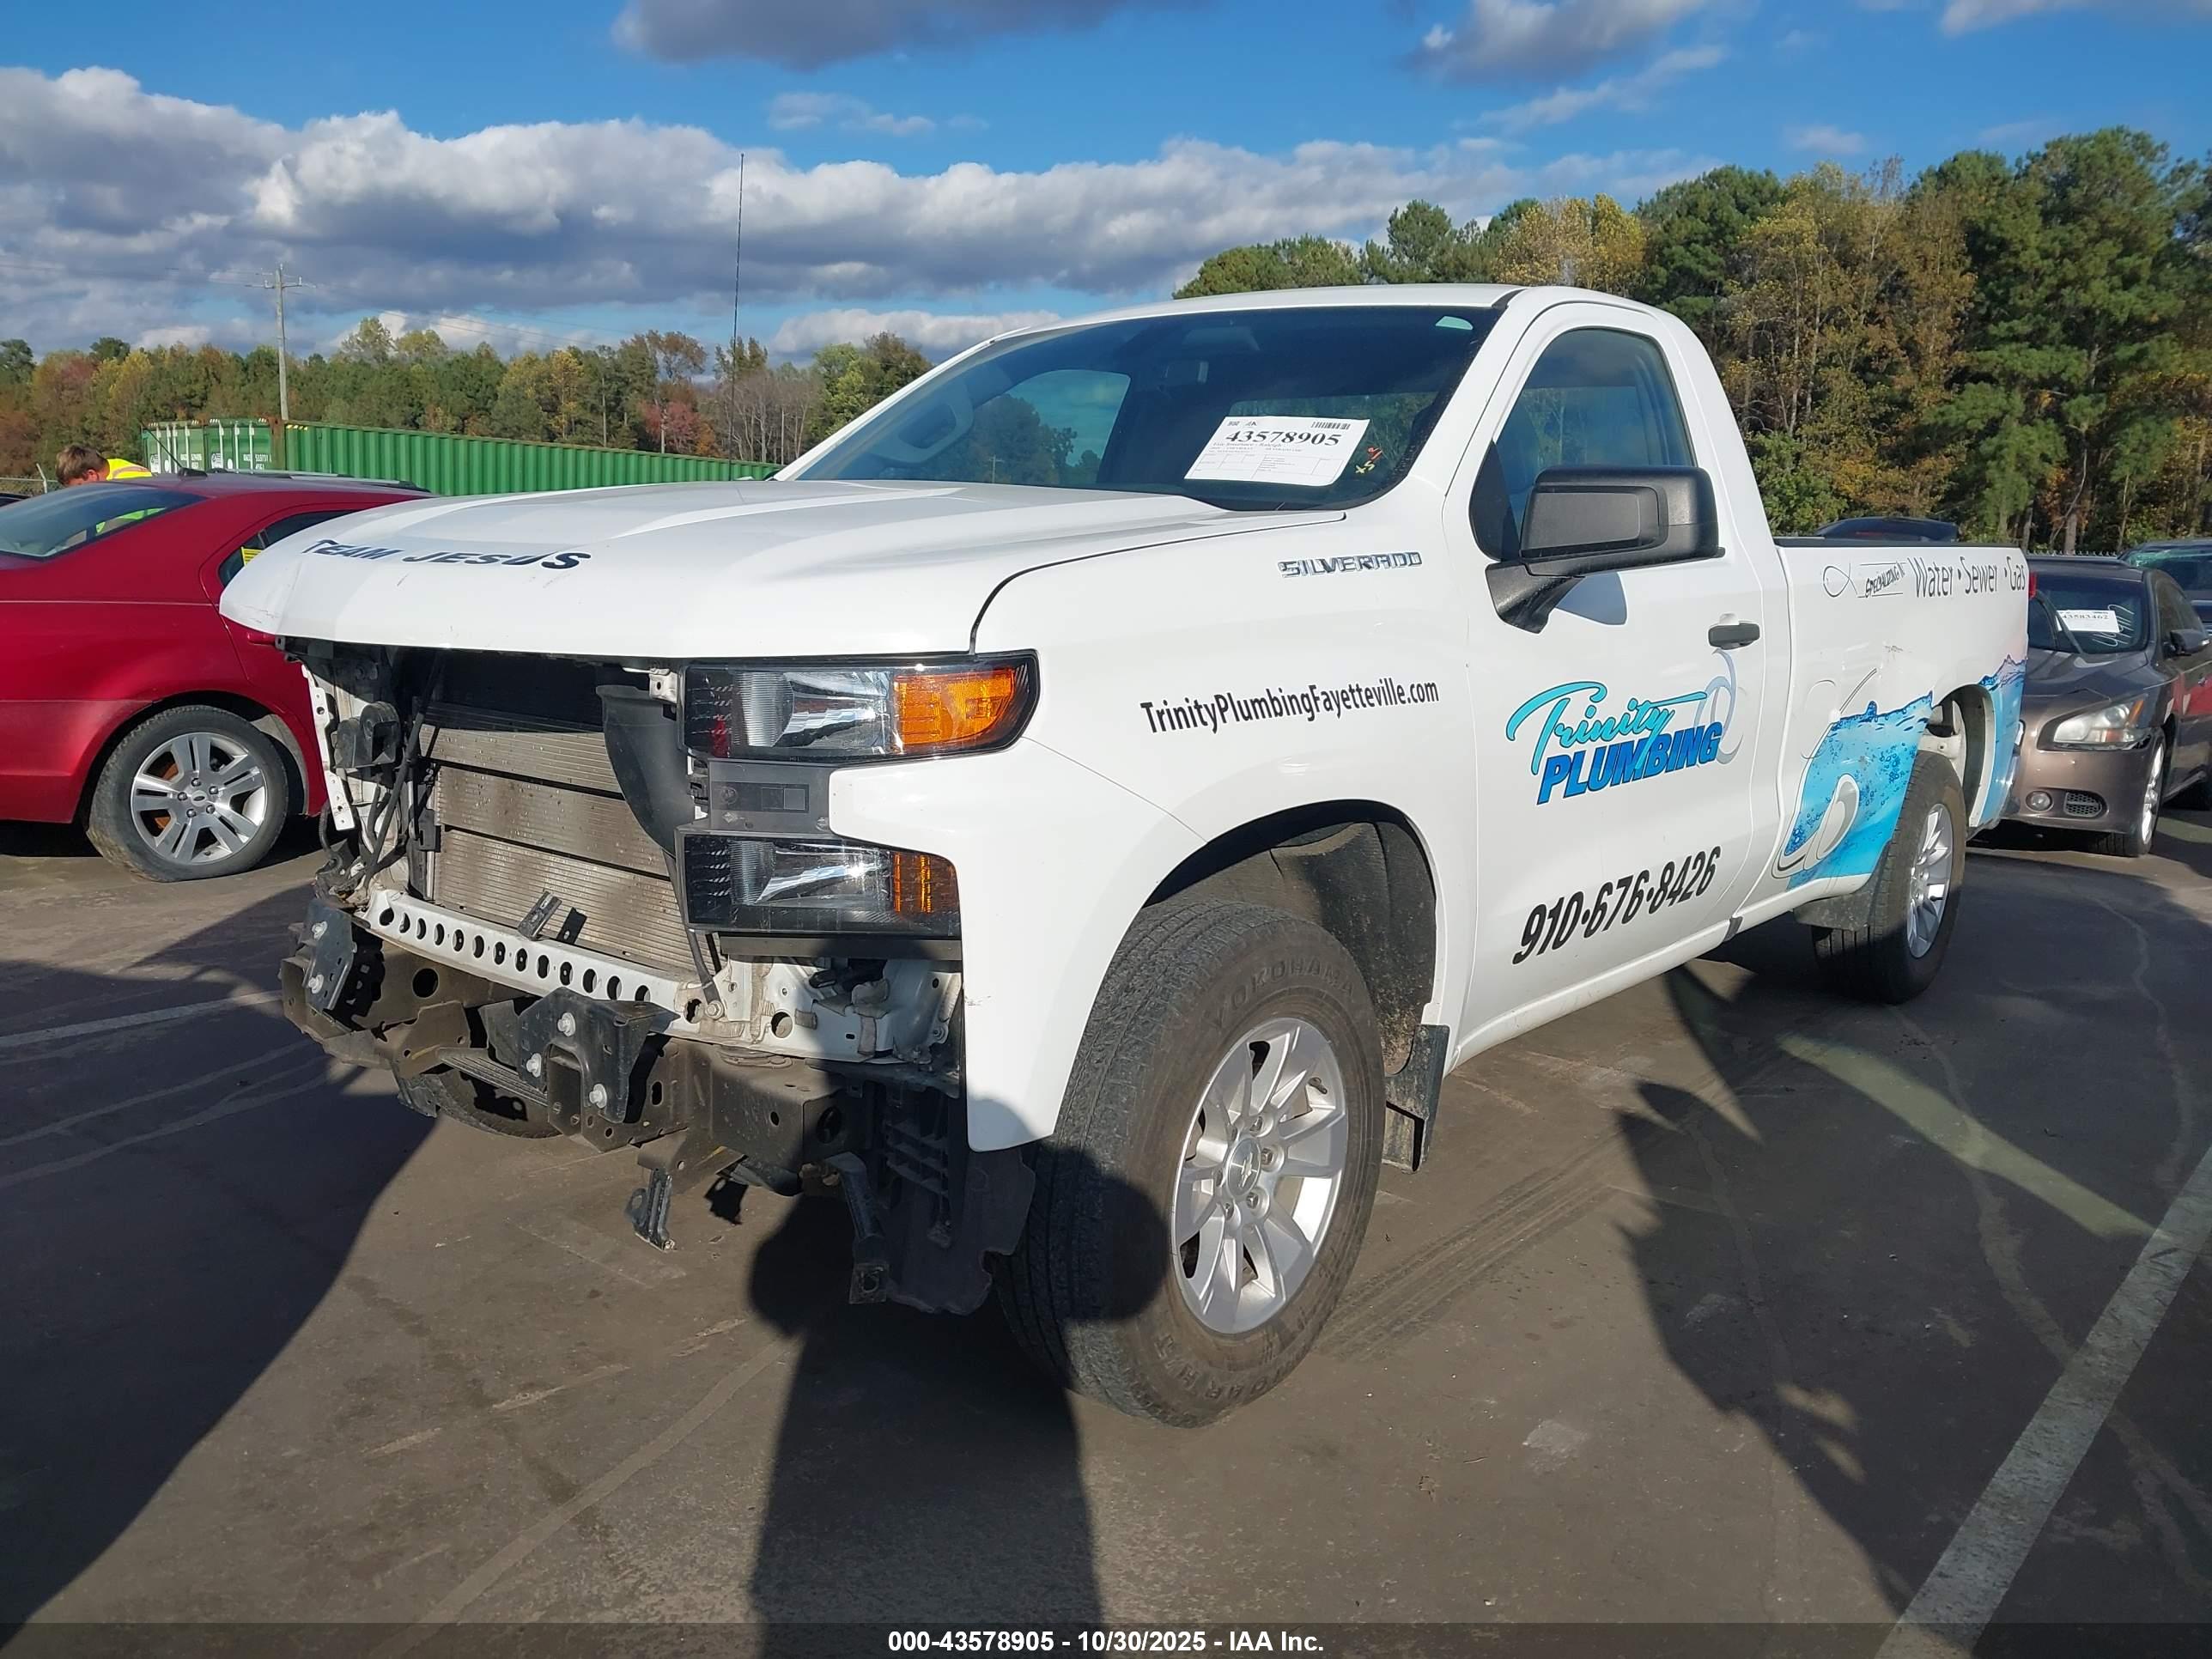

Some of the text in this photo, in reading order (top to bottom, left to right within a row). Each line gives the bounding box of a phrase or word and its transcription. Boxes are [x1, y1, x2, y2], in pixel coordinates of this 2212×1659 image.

[1226, 430, 1341, 446] 43578905
[301, 538, 592, 569] TEAM JESUS
[1277, 551, 1423, 578] SILVERADO
[1907, 556, 2027, 598] Water Sewer Gas
[1140, 677, 1439, 734] TrinityPlumbingFayetteville.com
[1505, 681, 1708, 775] Trinity
[1535, 720, 1726, 805] PLUMBING
[1205, 957, 1354, 1030] YOKOHAMA
